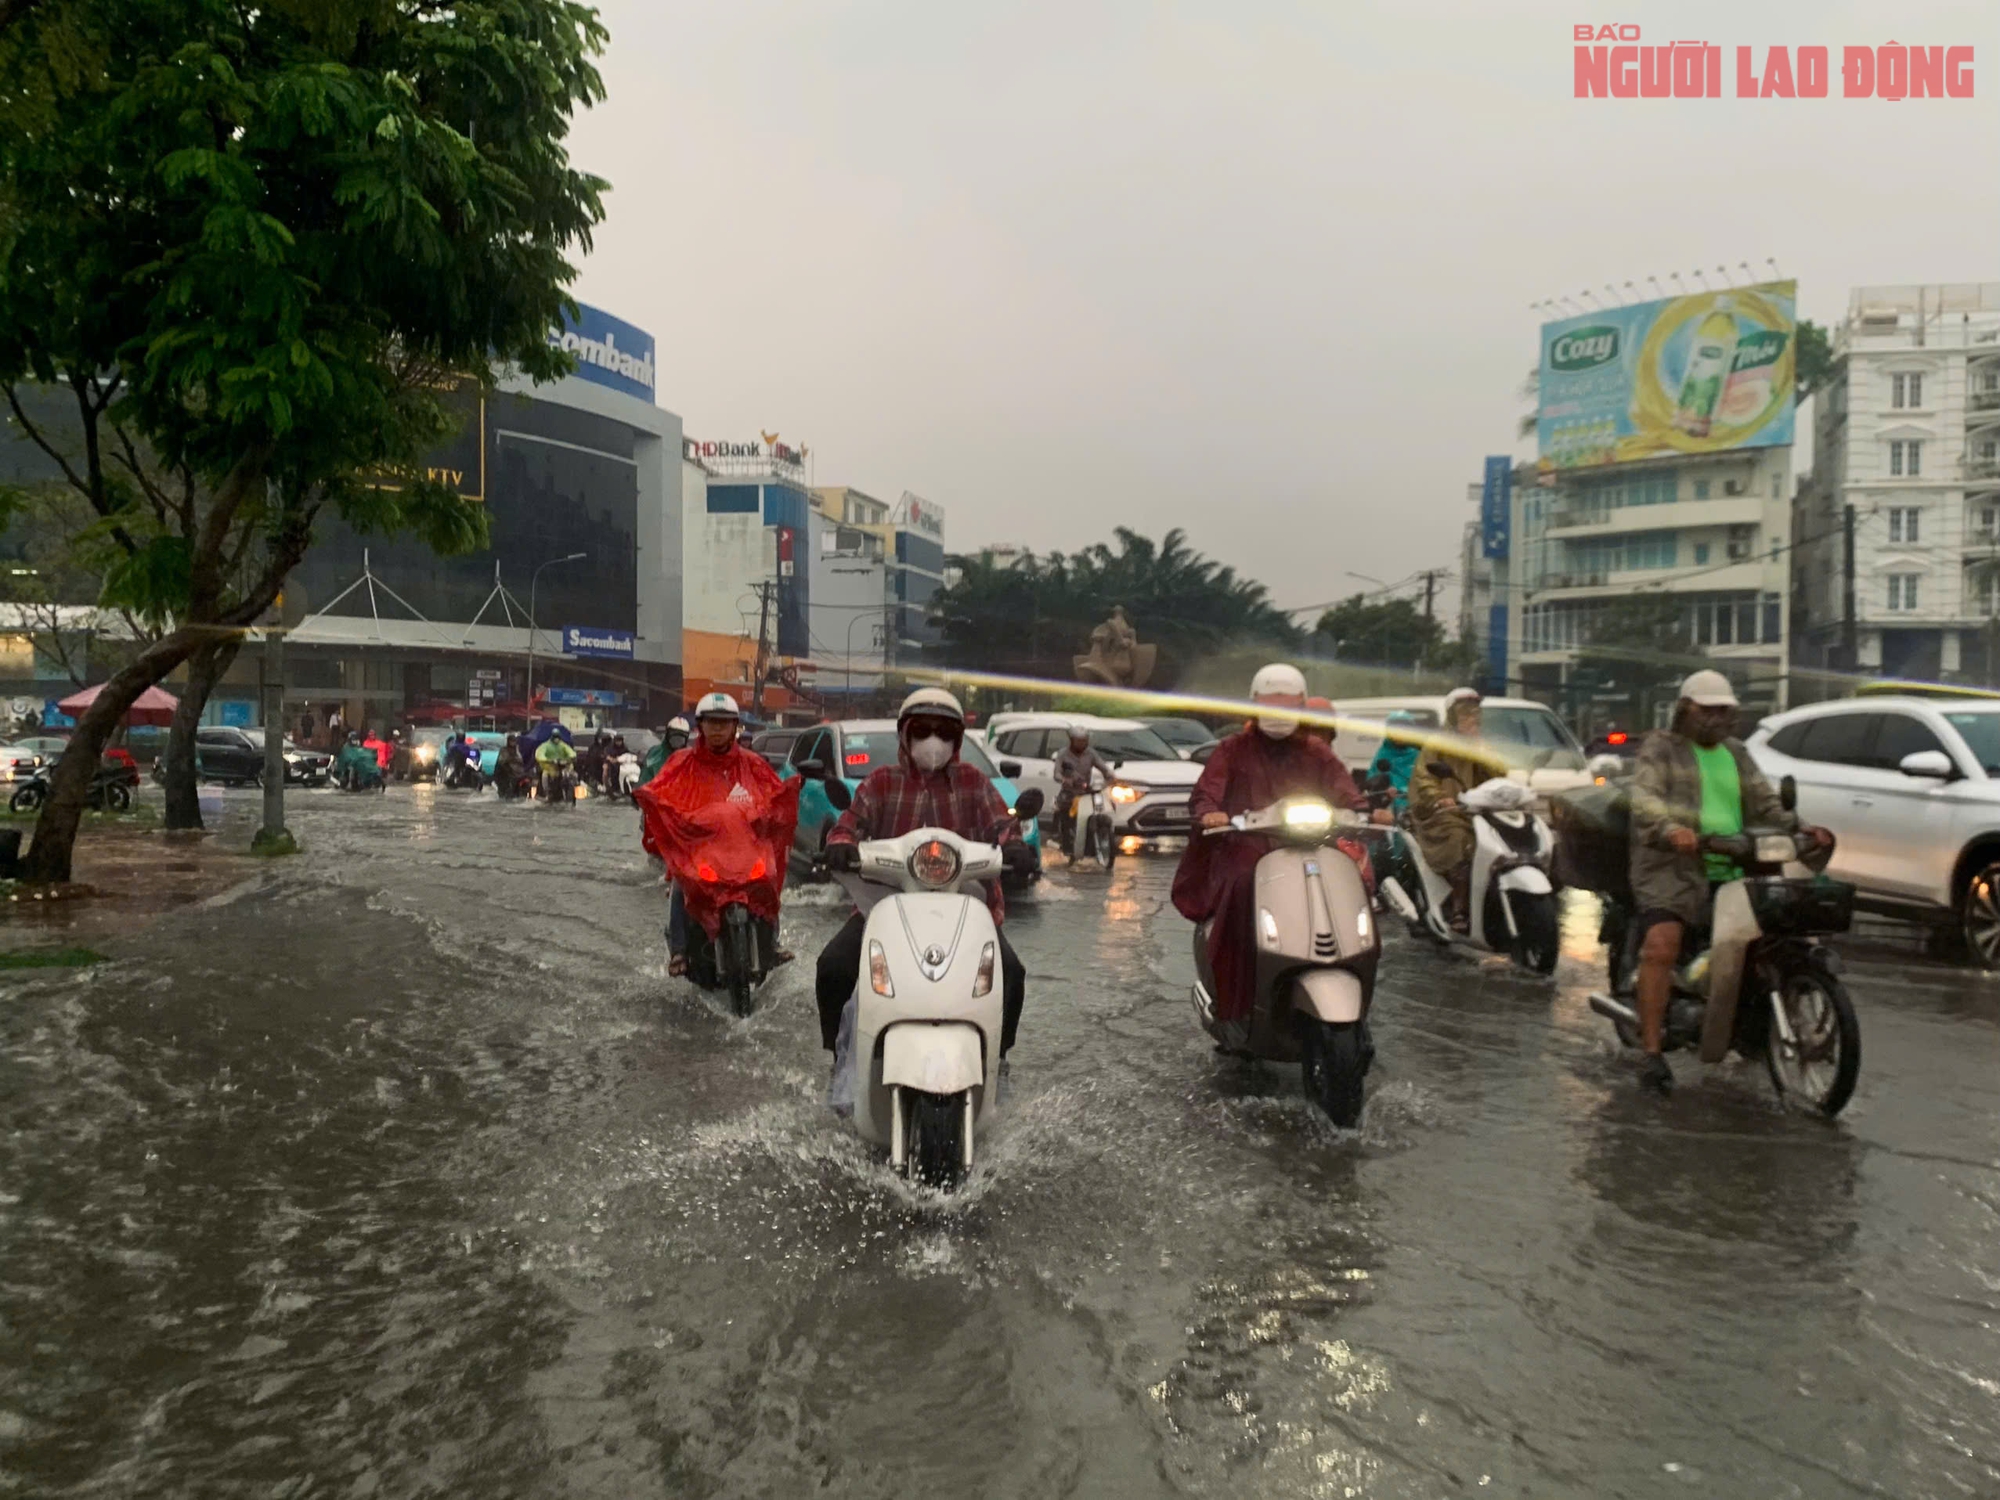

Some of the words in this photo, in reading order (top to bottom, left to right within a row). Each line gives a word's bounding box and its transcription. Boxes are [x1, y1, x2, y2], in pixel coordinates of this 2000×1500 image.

[545, 325, 654, 389] combank
[1554, 333, 1615, 363] Cozy
[694, 441, 760, 457] HDBank
[427, 467, 463, 487] KTV
[569, 629, 632, 652] Sacombank
